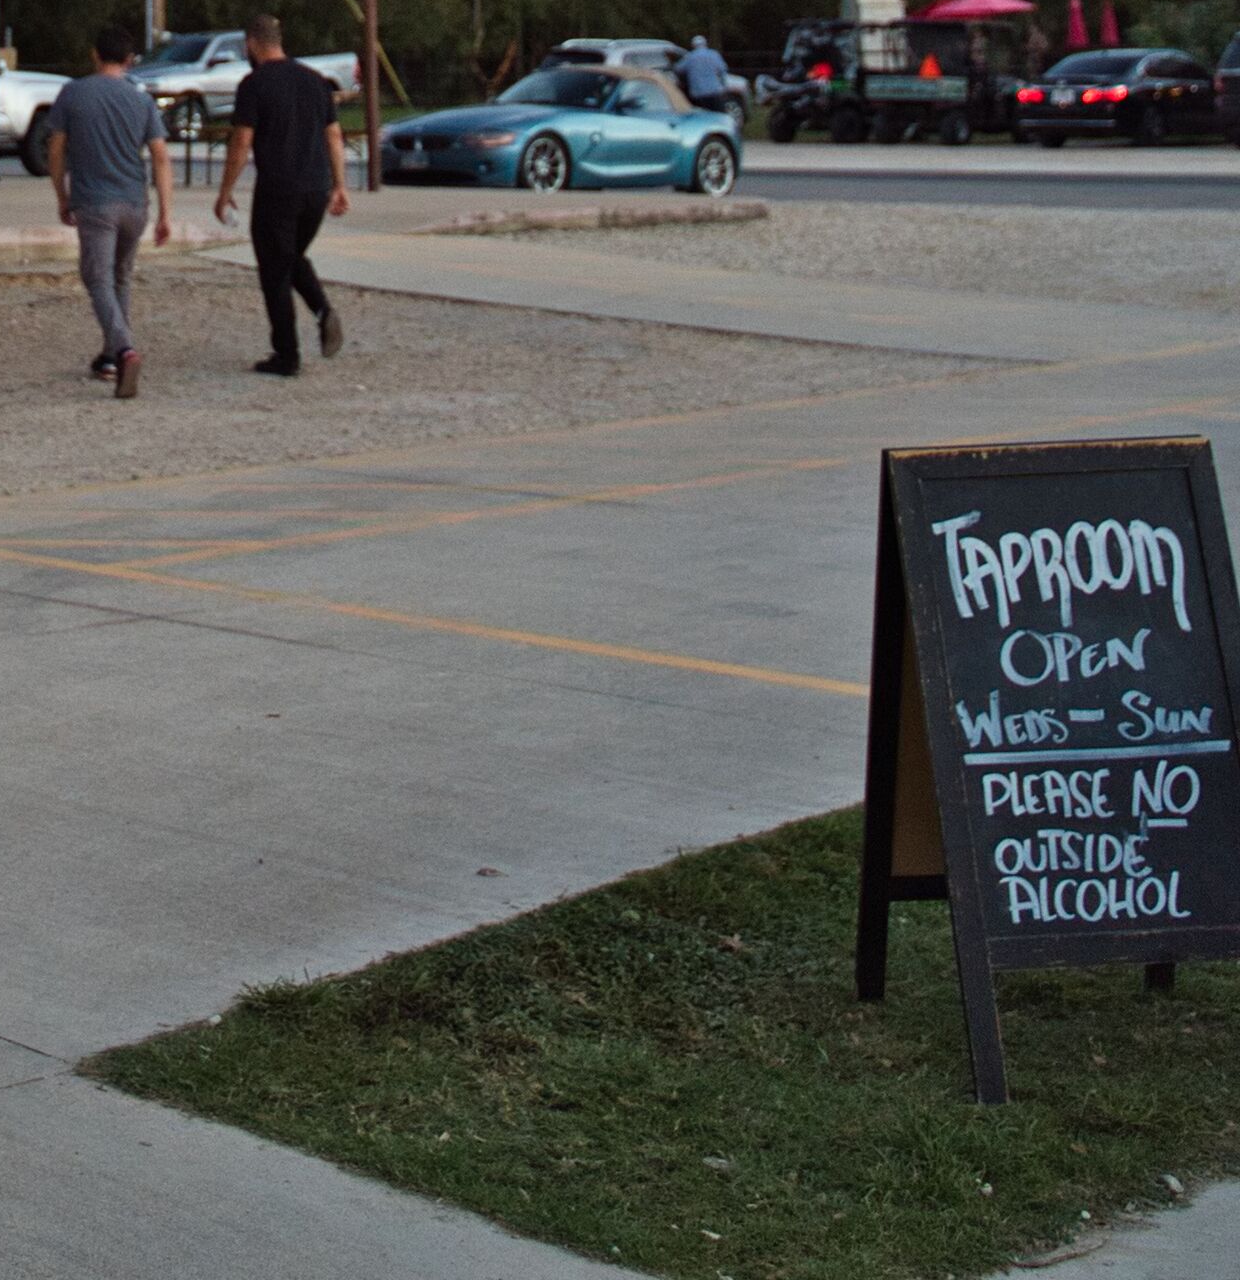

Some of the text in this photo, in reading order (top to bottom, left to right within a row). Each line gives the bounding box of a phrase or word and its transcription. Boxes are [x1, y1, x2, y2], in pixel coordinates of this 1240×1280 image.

[931, 510, 1192, 632] TAPROOM
[982, 760, 1200, 818] PLEASE NO
[994, 829, 1153, 878] OUTSIDE
[999, 871, 1191, 924] ALCOHOL
